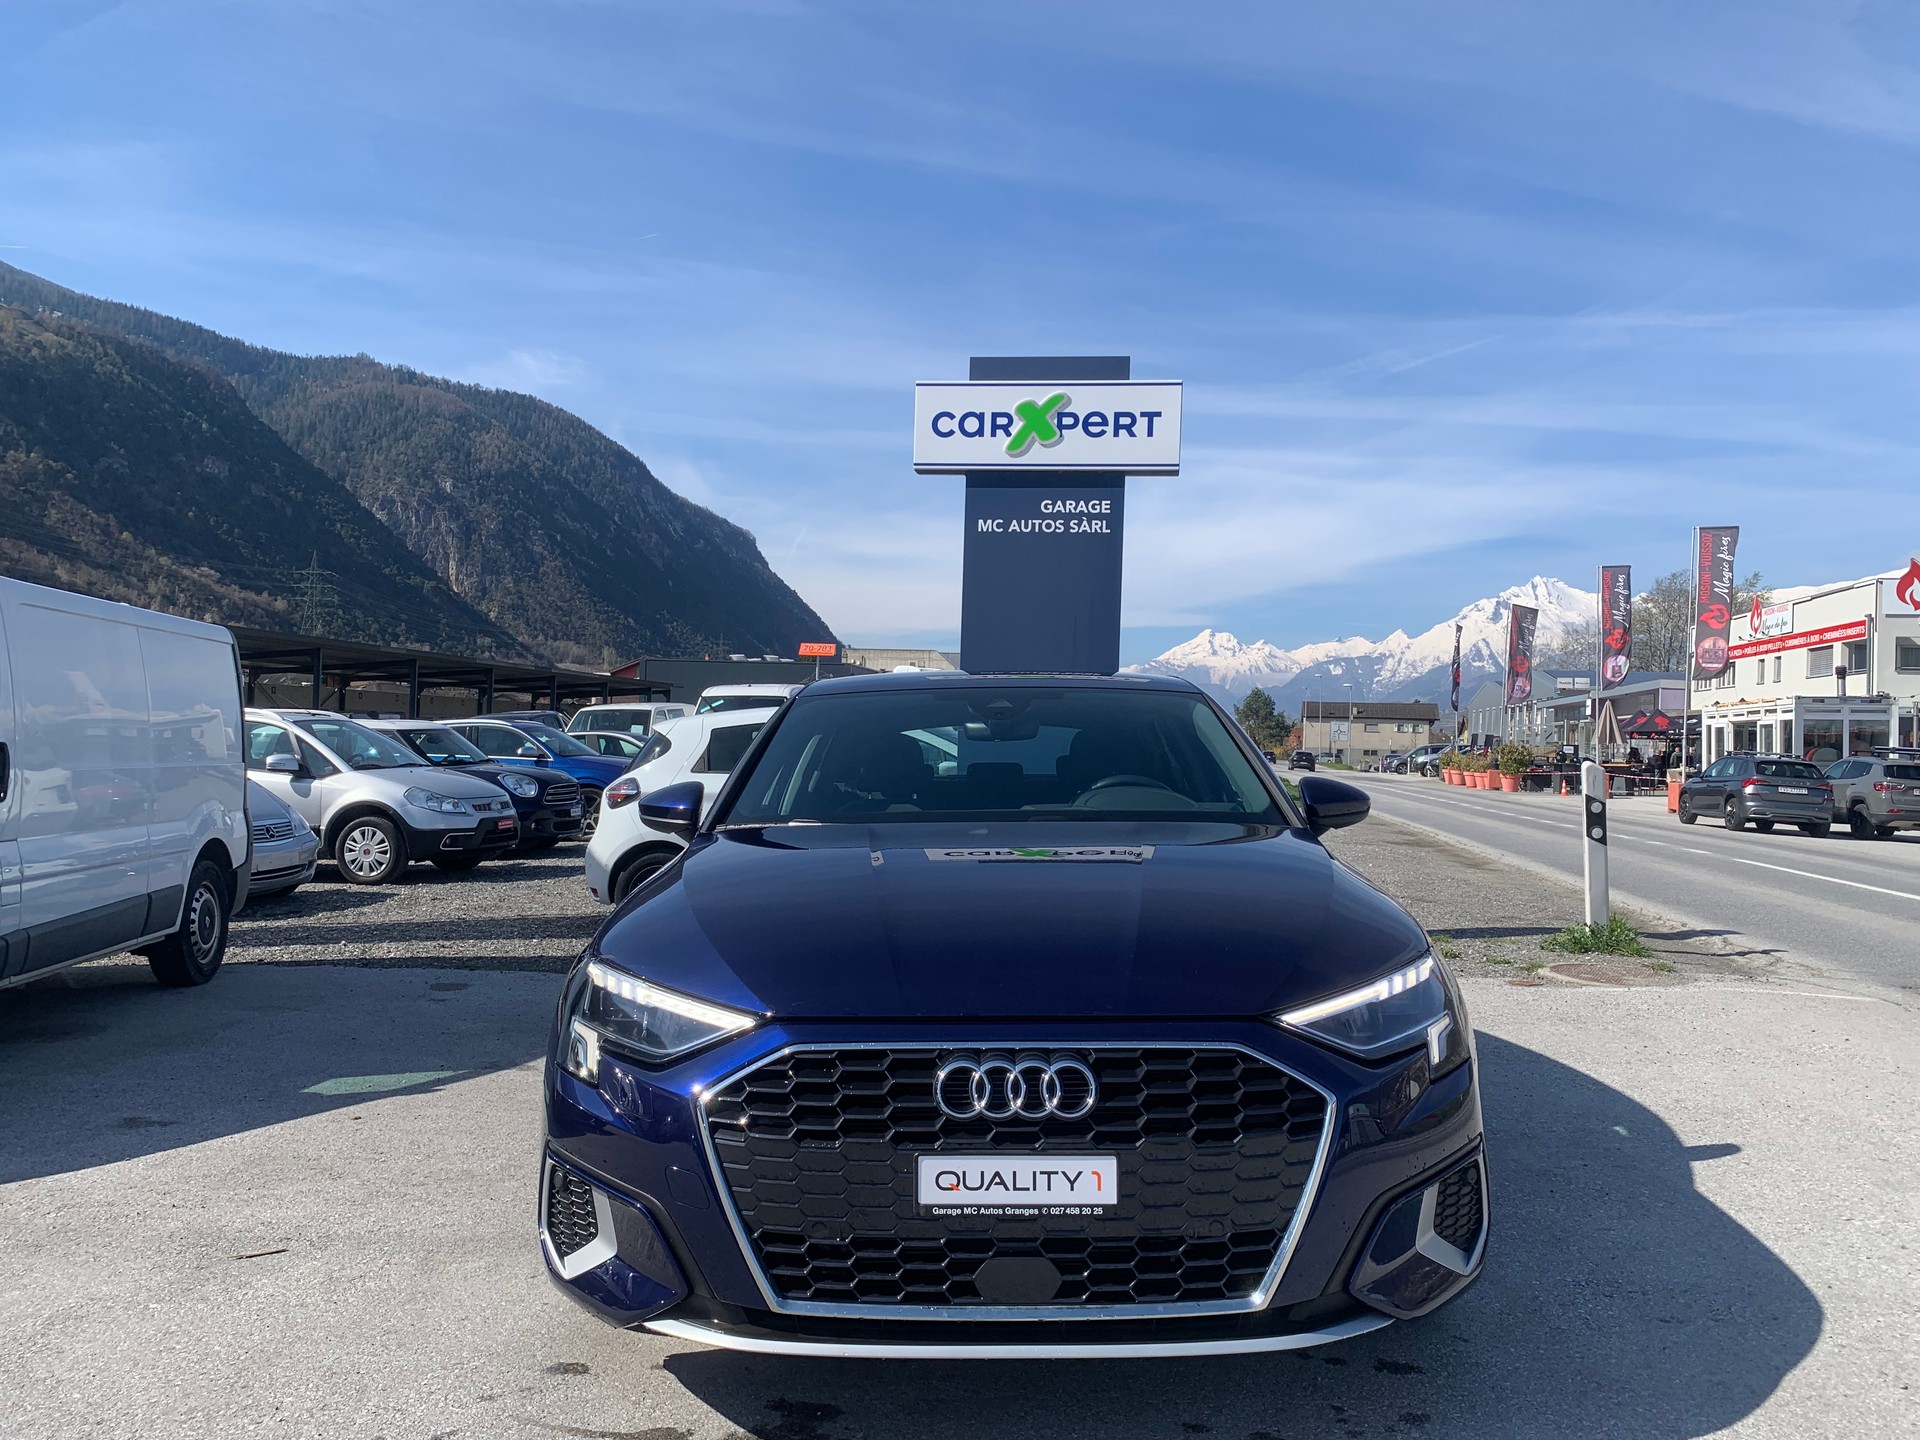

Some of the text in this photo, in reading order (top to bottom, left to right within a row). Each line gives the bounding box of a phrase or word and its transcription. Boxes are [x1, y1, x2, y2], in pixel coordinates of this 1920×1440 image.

[1040, 500, 1111, 514] GARAGE
[977, 517, 1111, 533] MC AUTOS SÀRL
[935, 1170, 1084, 1192] QUALITY
[932, 1207, 1103, 1216] Garage MC Autos Granges 027 458 20 25
